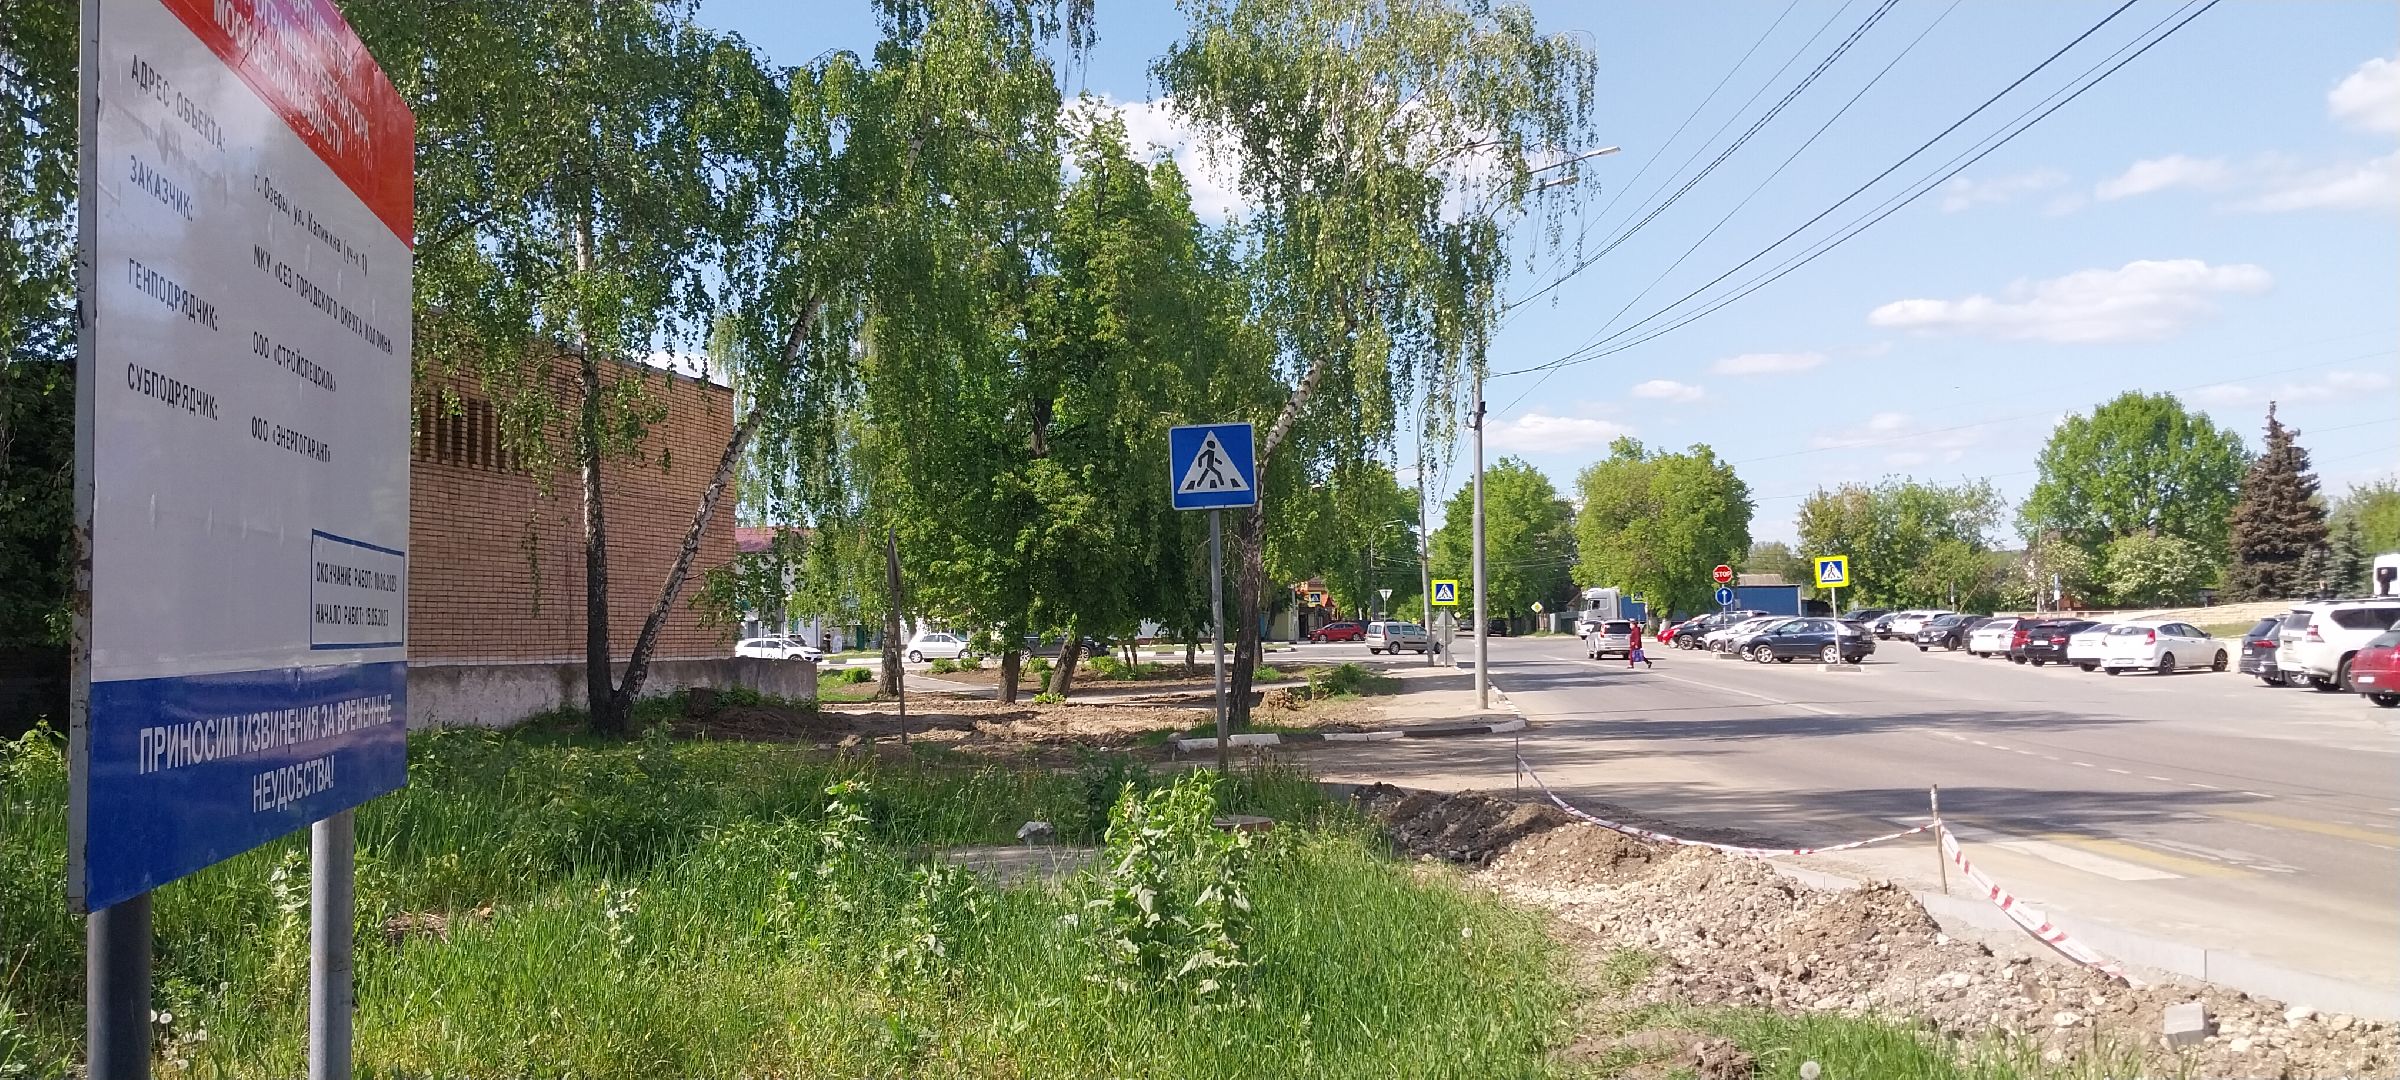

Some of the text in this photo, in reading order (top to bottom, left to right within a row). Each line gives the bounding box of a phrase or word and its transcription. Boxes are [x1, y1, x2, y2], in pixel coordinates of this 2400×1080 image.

[131, 54, 226, 153] АДРЕС ОБЪЕКТА:
[300, 86, 343, 158] ОБЛАСТИ
[130, 154, 193, 222] ЗАКАЗЧИК:
[253, 174, 261, 193] г.
[293, 205, 305, 226] ул.
[308, 210, 341, 253] Калинина
[128, 257, 218, 332] ГЕНПОДРЯДЧИК:
[253, 244, 393, 355] МКУ «СЕЗ ГОРОДСКОГО ОКРУГА КОЛОМНА»
[127, 361, 218, 421] СУБПОДРЯДЧИК:
[253, 331, 337, 392] ООО «СТРОЙСПЕЦСИЛА»
[251, 415, 331, 463] ООО «ЭНЕРГОГАРАНТ»
[316, 561, 352, 587] ОКОНЧАНИЕ
[354, 568, 373, 589] РАБОТ:
[315, 603, 342, 625] НАЧАЛО
[344, 605, 364, 626] РАБОТ:
[139, 693, 392, 775] ПРИНОСИМ ИЗВИНЕНИЯ ЗА ВРЕМЕННЫЕ
[253, 754, 335, 814] НЕУДОБСТВА!
